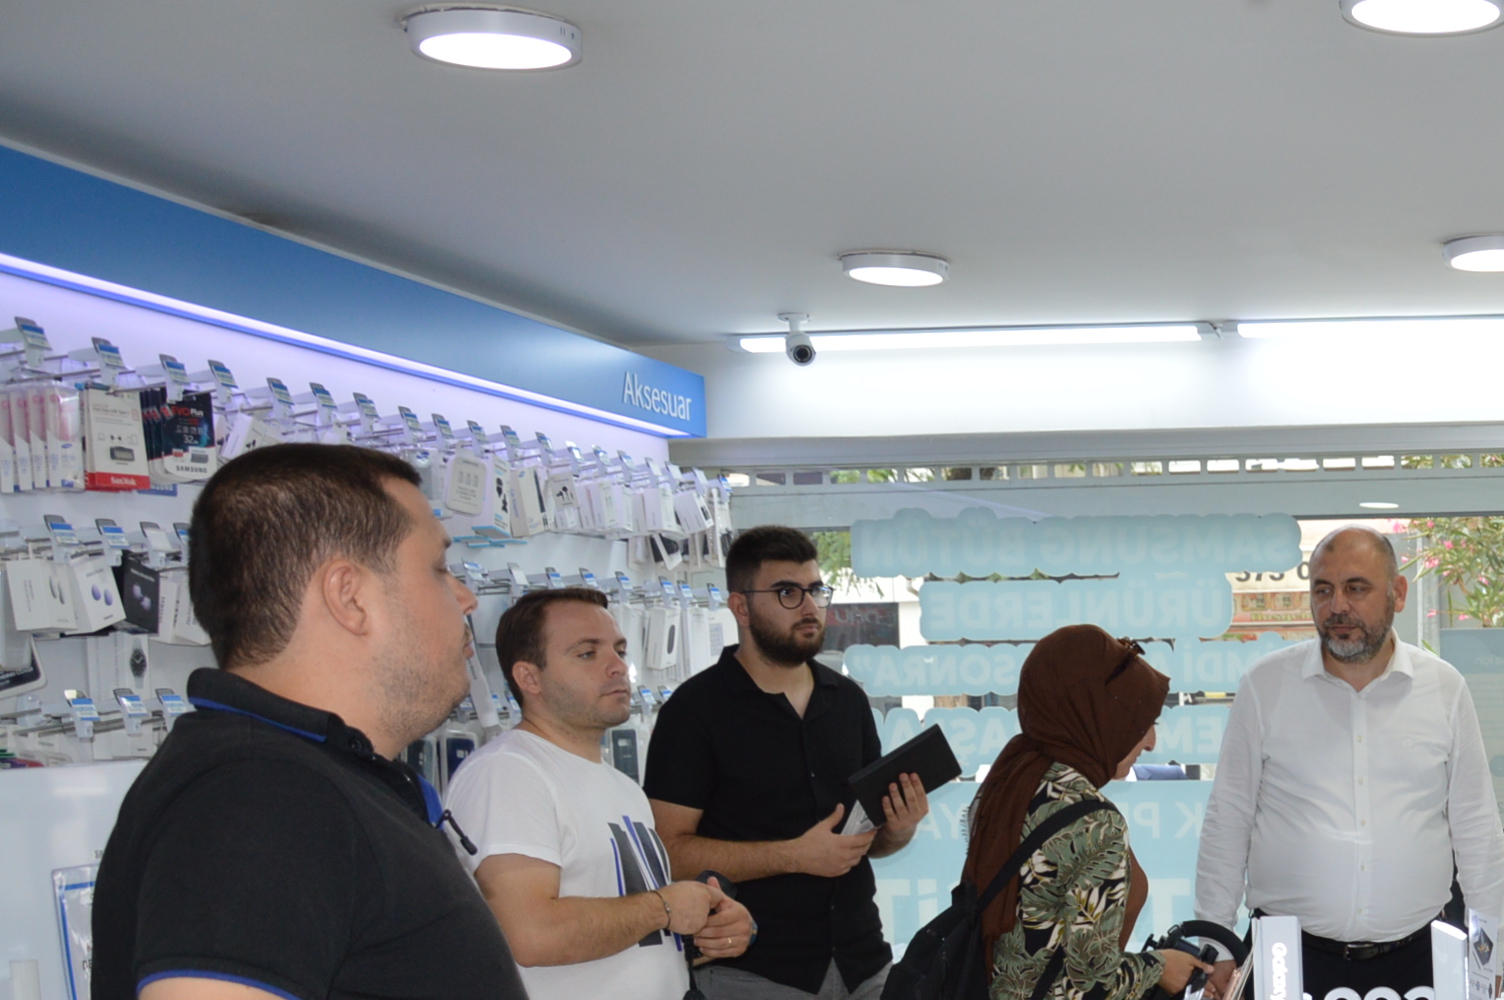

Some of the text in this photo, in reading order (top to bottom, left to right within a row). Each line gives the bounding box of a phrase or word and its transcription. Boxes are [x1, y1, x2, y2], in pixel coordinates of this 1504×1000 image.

[622, 371, 692, 421] Aksesuar
[176, 465, 207, 473] SAMSUNG
[111, 476, 137, 487] SanDisk
